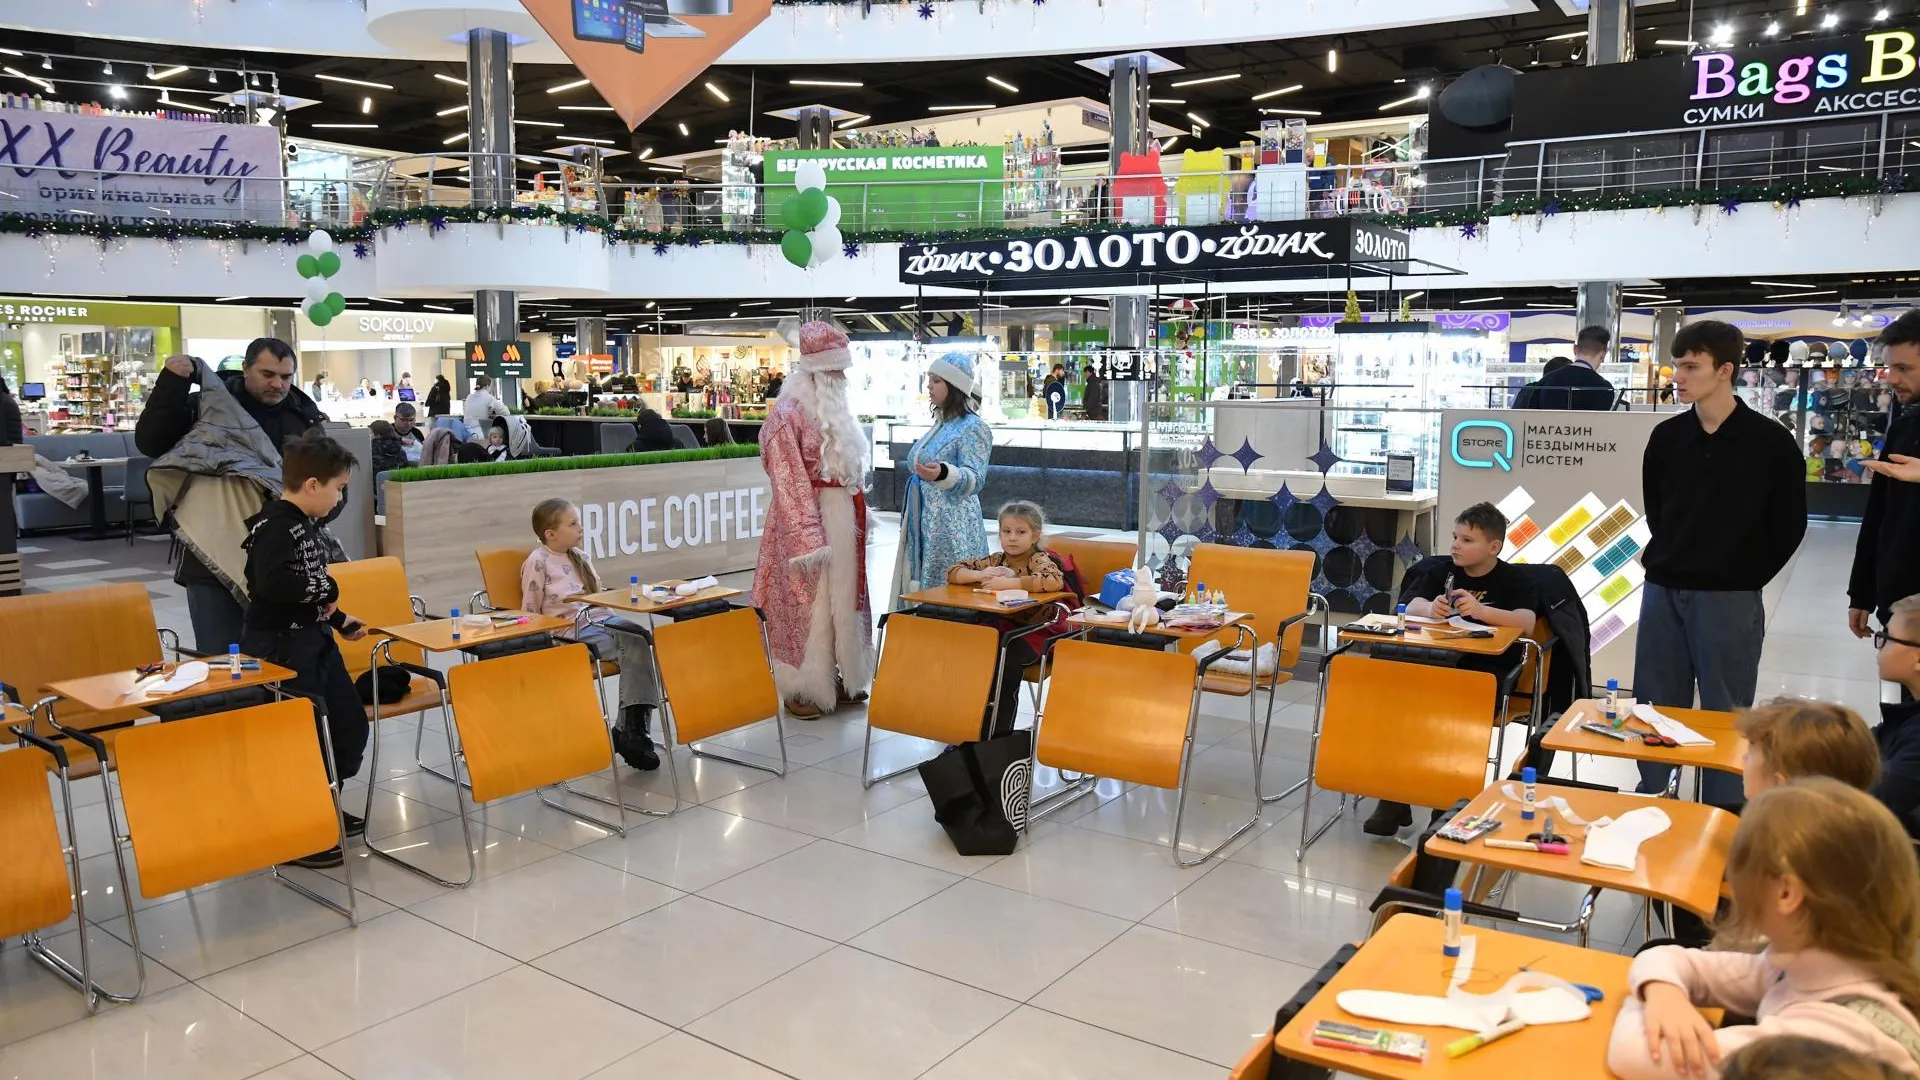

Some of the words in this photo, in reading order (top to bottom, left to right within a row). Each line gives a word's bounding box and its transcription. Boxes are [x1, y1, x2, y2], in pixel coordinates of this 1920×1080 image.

[1689, 53, 1849, 104] Bags
[1861, 31, 1920, 83] B
[1683, 102, 1765, 124] СУМКИ
[93, 126, 259, 204] Beauty
[892, 155, 988, 169] КОСМЕТИКА
[1004, 230, 1200, 271] ЗОЛОТО
[1355, 229, 1406, 263] ЗОЛОТО
[20, 305, 88, 317] ROCHER
[359, 316, 435, 334] SOKOLOV
[1527, 425, 1592, 437] МАГАЗИН
[1462, 438, 1503, 448] STORE
[1526, 439, 1617, 453] БЕЗДЫМНЫХ
[1526, 454, 1583, 466] СИСТЕМ
[582, 498, 658, 560] RICE
[663, 487, 766, 549] COFFEE
